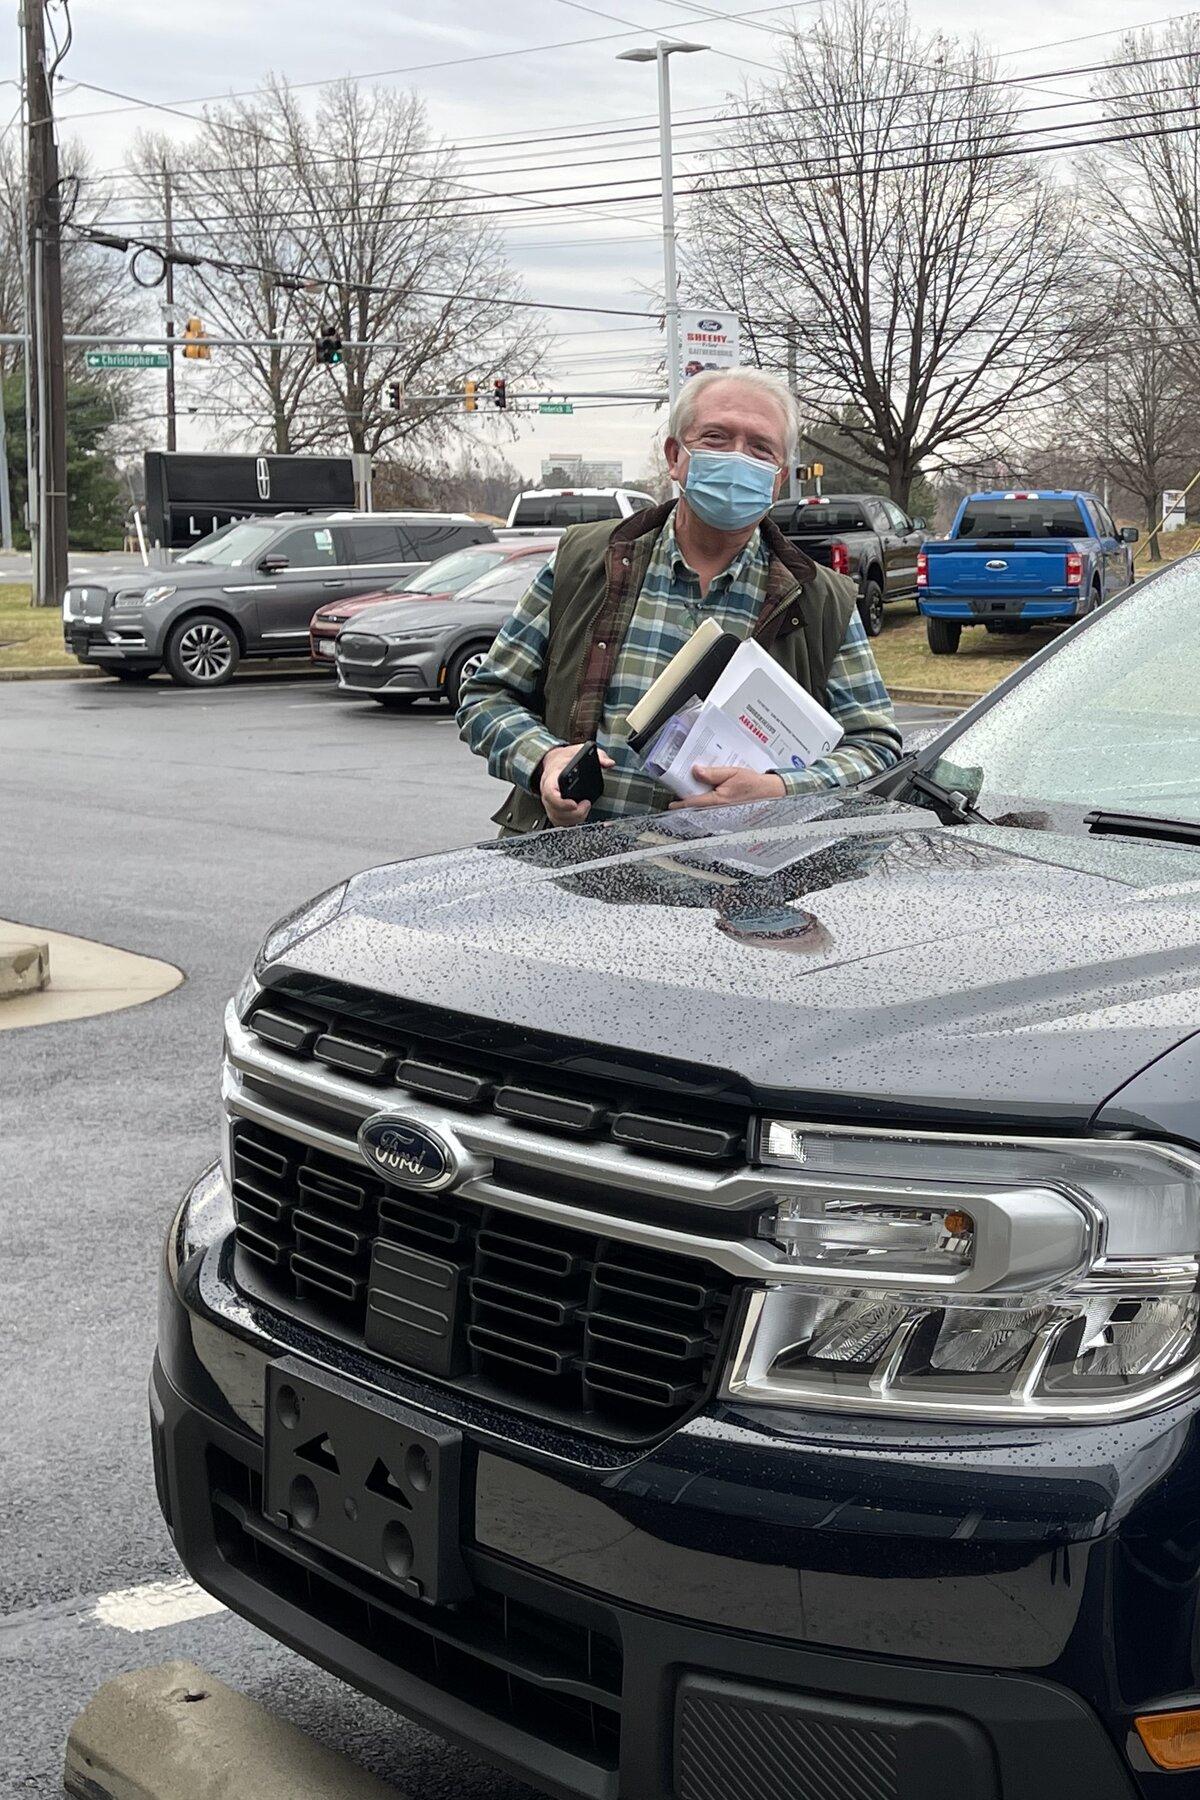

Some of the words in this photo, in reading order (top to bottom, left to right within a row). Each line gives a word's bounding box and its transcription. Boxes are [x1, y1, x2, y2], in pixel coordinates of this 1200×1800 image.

[687, 333, 727, 343] SHEEHY
[101, 354, 155, 368] Christopher
[738, 714, 769, 744] SHEEHY
[375, 1129, 425, 1175] Ford
